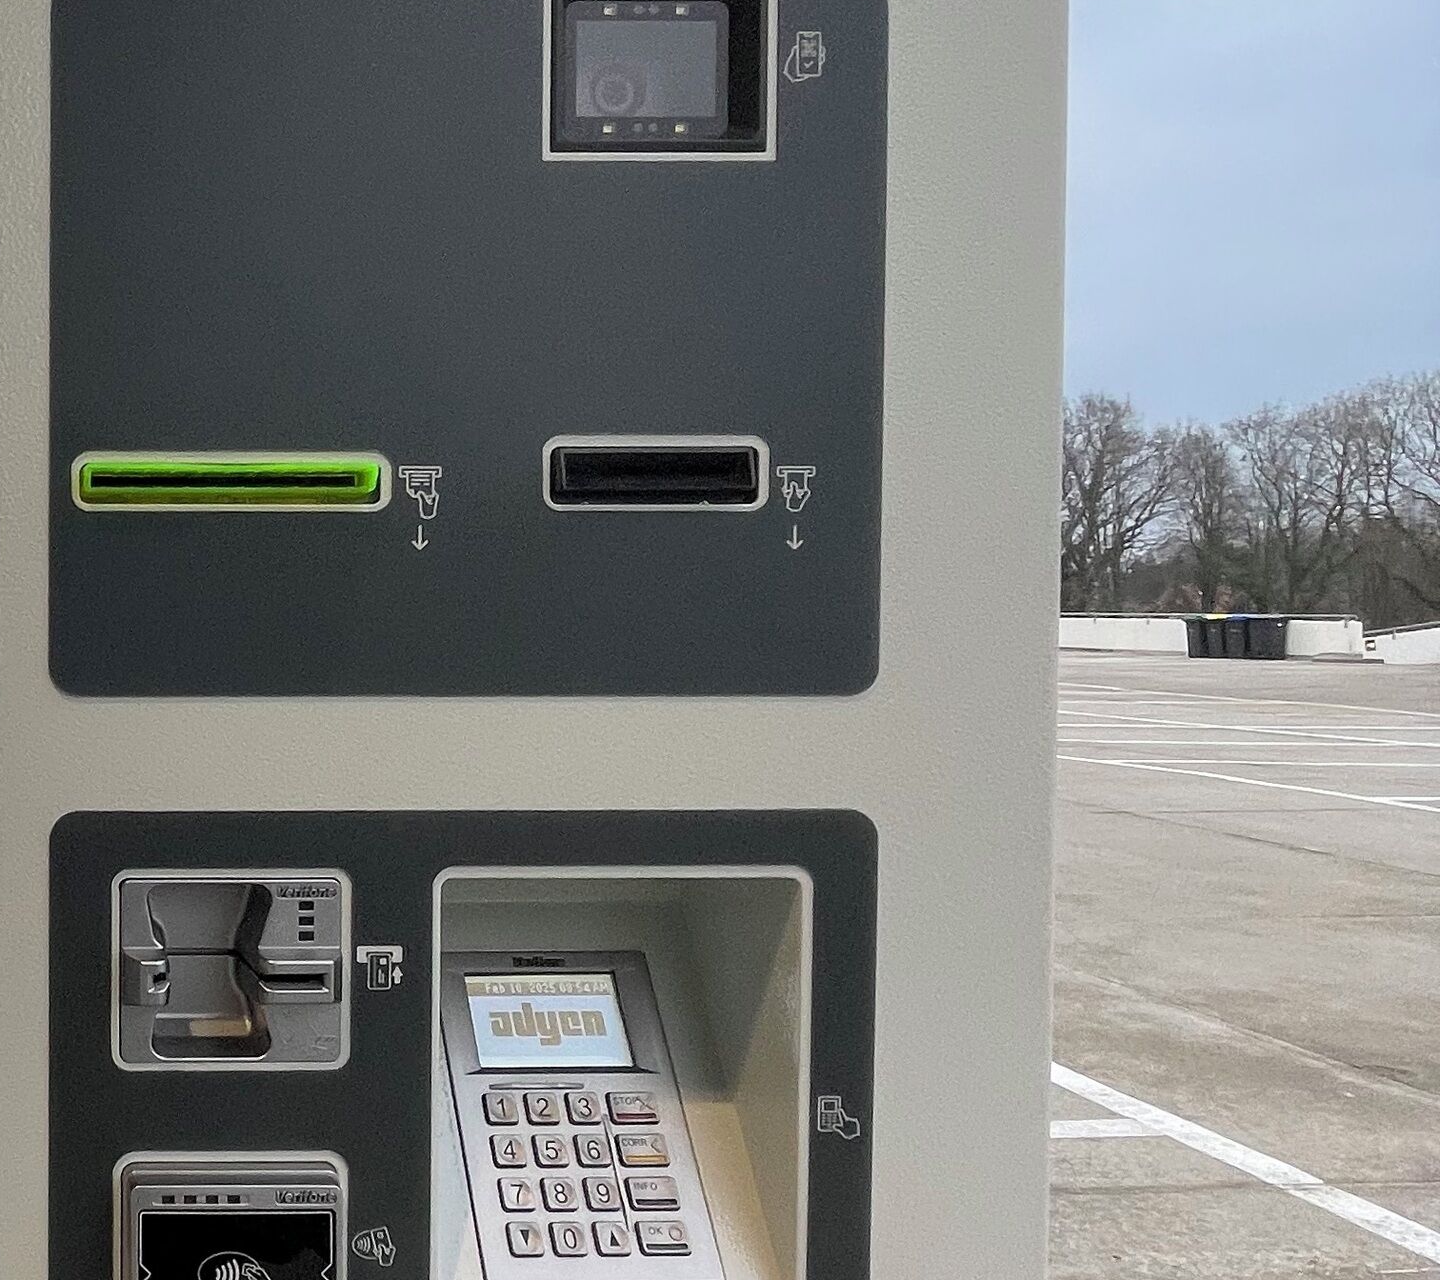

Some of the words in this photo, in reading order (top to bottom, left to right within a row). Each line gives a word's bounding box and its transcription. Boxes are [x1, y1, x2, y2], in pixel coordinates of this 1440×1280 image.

[489, 1002, 607, 1046] adyen
[496, 1098, 506, 1117] 1
[536, 1097, 551, 1117] 2
[577, 1097, 592, 1117] 3
[503, 1140, 516, 1160] 4
[545, 1140, 559, 1160] 5
[586, 1140, 601, 1160] 6
[511, 1184, 523, 1204] 7
[554, 1183, 568, 1204] 8
[596, 1183, 610, 1204] 9
[648, 1226, 663, 1235] OK
